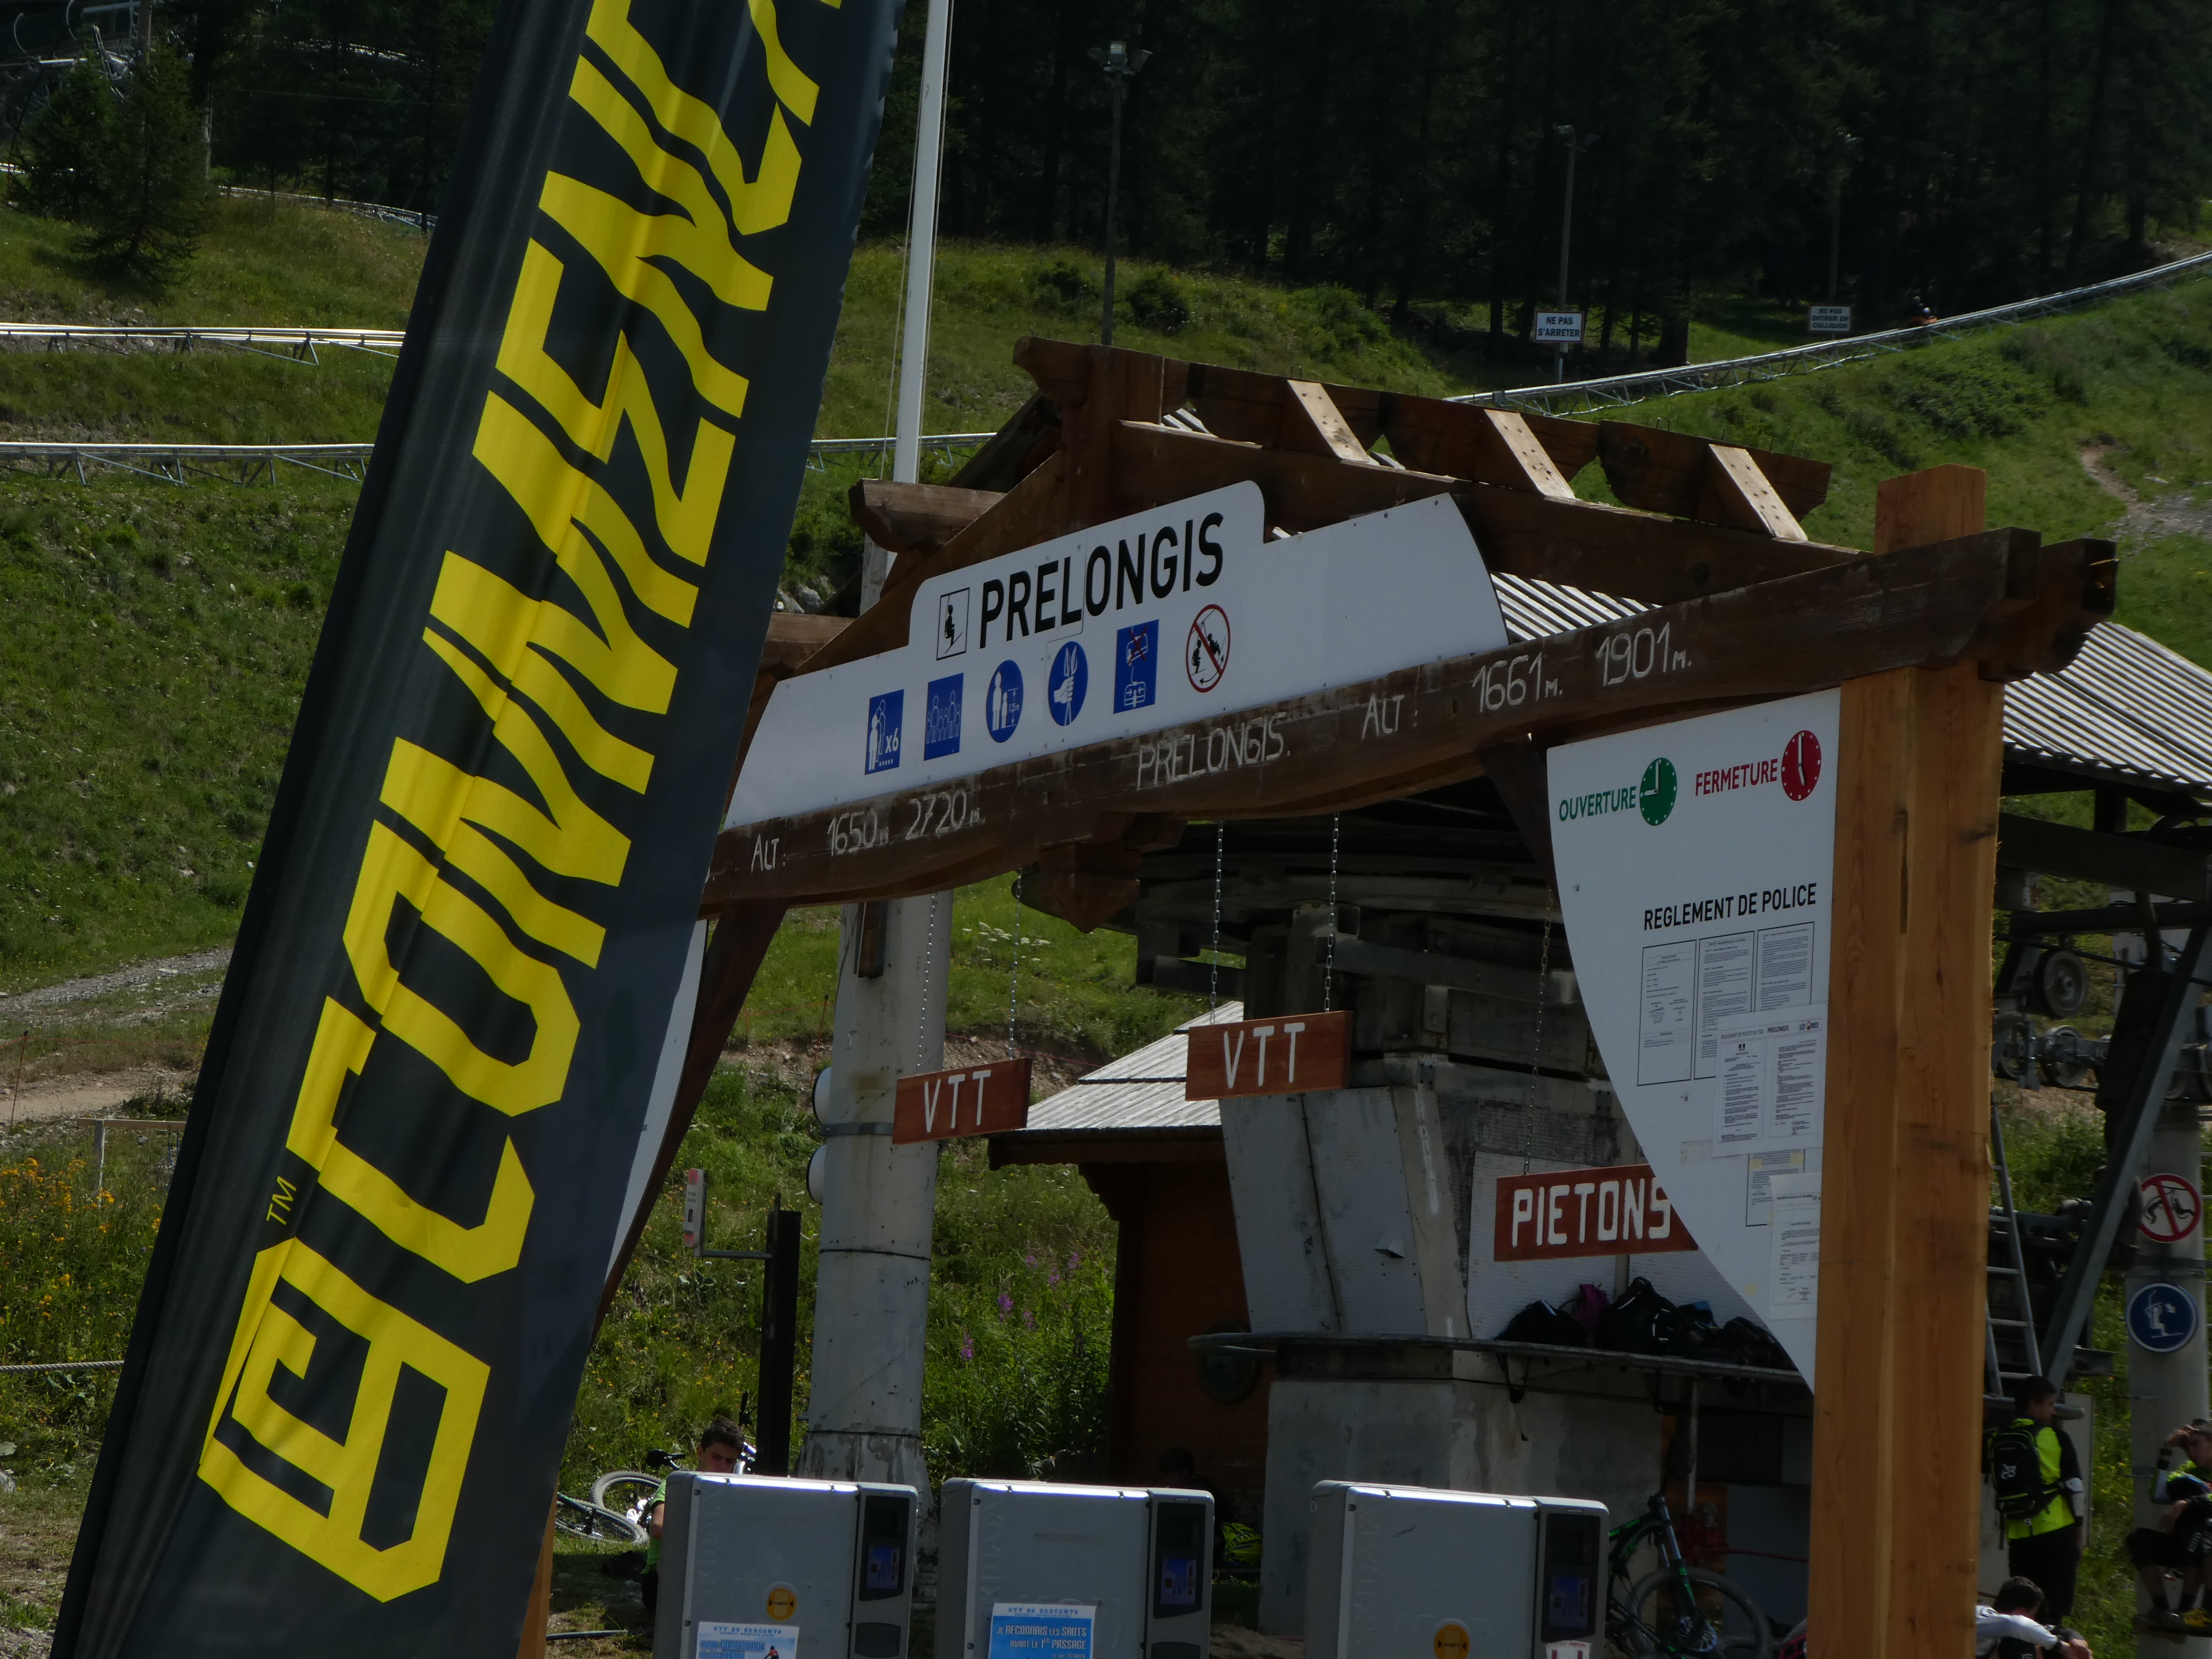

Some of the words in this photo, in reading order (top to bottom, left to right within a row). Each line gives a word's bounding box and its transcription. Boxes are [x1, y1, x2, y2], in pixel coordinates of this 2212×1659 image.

[1538, 328, 1580, 337] S'ARRETER
[1546, 316, 1557, 324] NE
[1558, 317, 1573, 325] PAS
[979, 512, 1224, 649] PRELONGIS
[1695, 758, 1778, 796] FERMETURE
[1559, 785, 1636, 821] OUVERTURE
[1644, 896, 1734, 931] REGLEMENT
[1738, 892, 1757, 916] DE
[1762, 882, 1817, 912] POLICE
[1767, 1025, 1789, 1033] PRELONGIS
[1223, 1022, 1305, 1089] VTT
[923, 1069, 991, 1134] VTT
[266, 1176, 298, 1225] TM
[1512, 1176, 1671, 1248] PIETONS
[721, 1640, 765, 1651] CONSCIENCE
[1006, 1625, 1048, 1636] RECONNAIS
[1062, 1626, 1087, 1637] SAUTS
[1052, 1640, 1086, 1650] PASSAGE
